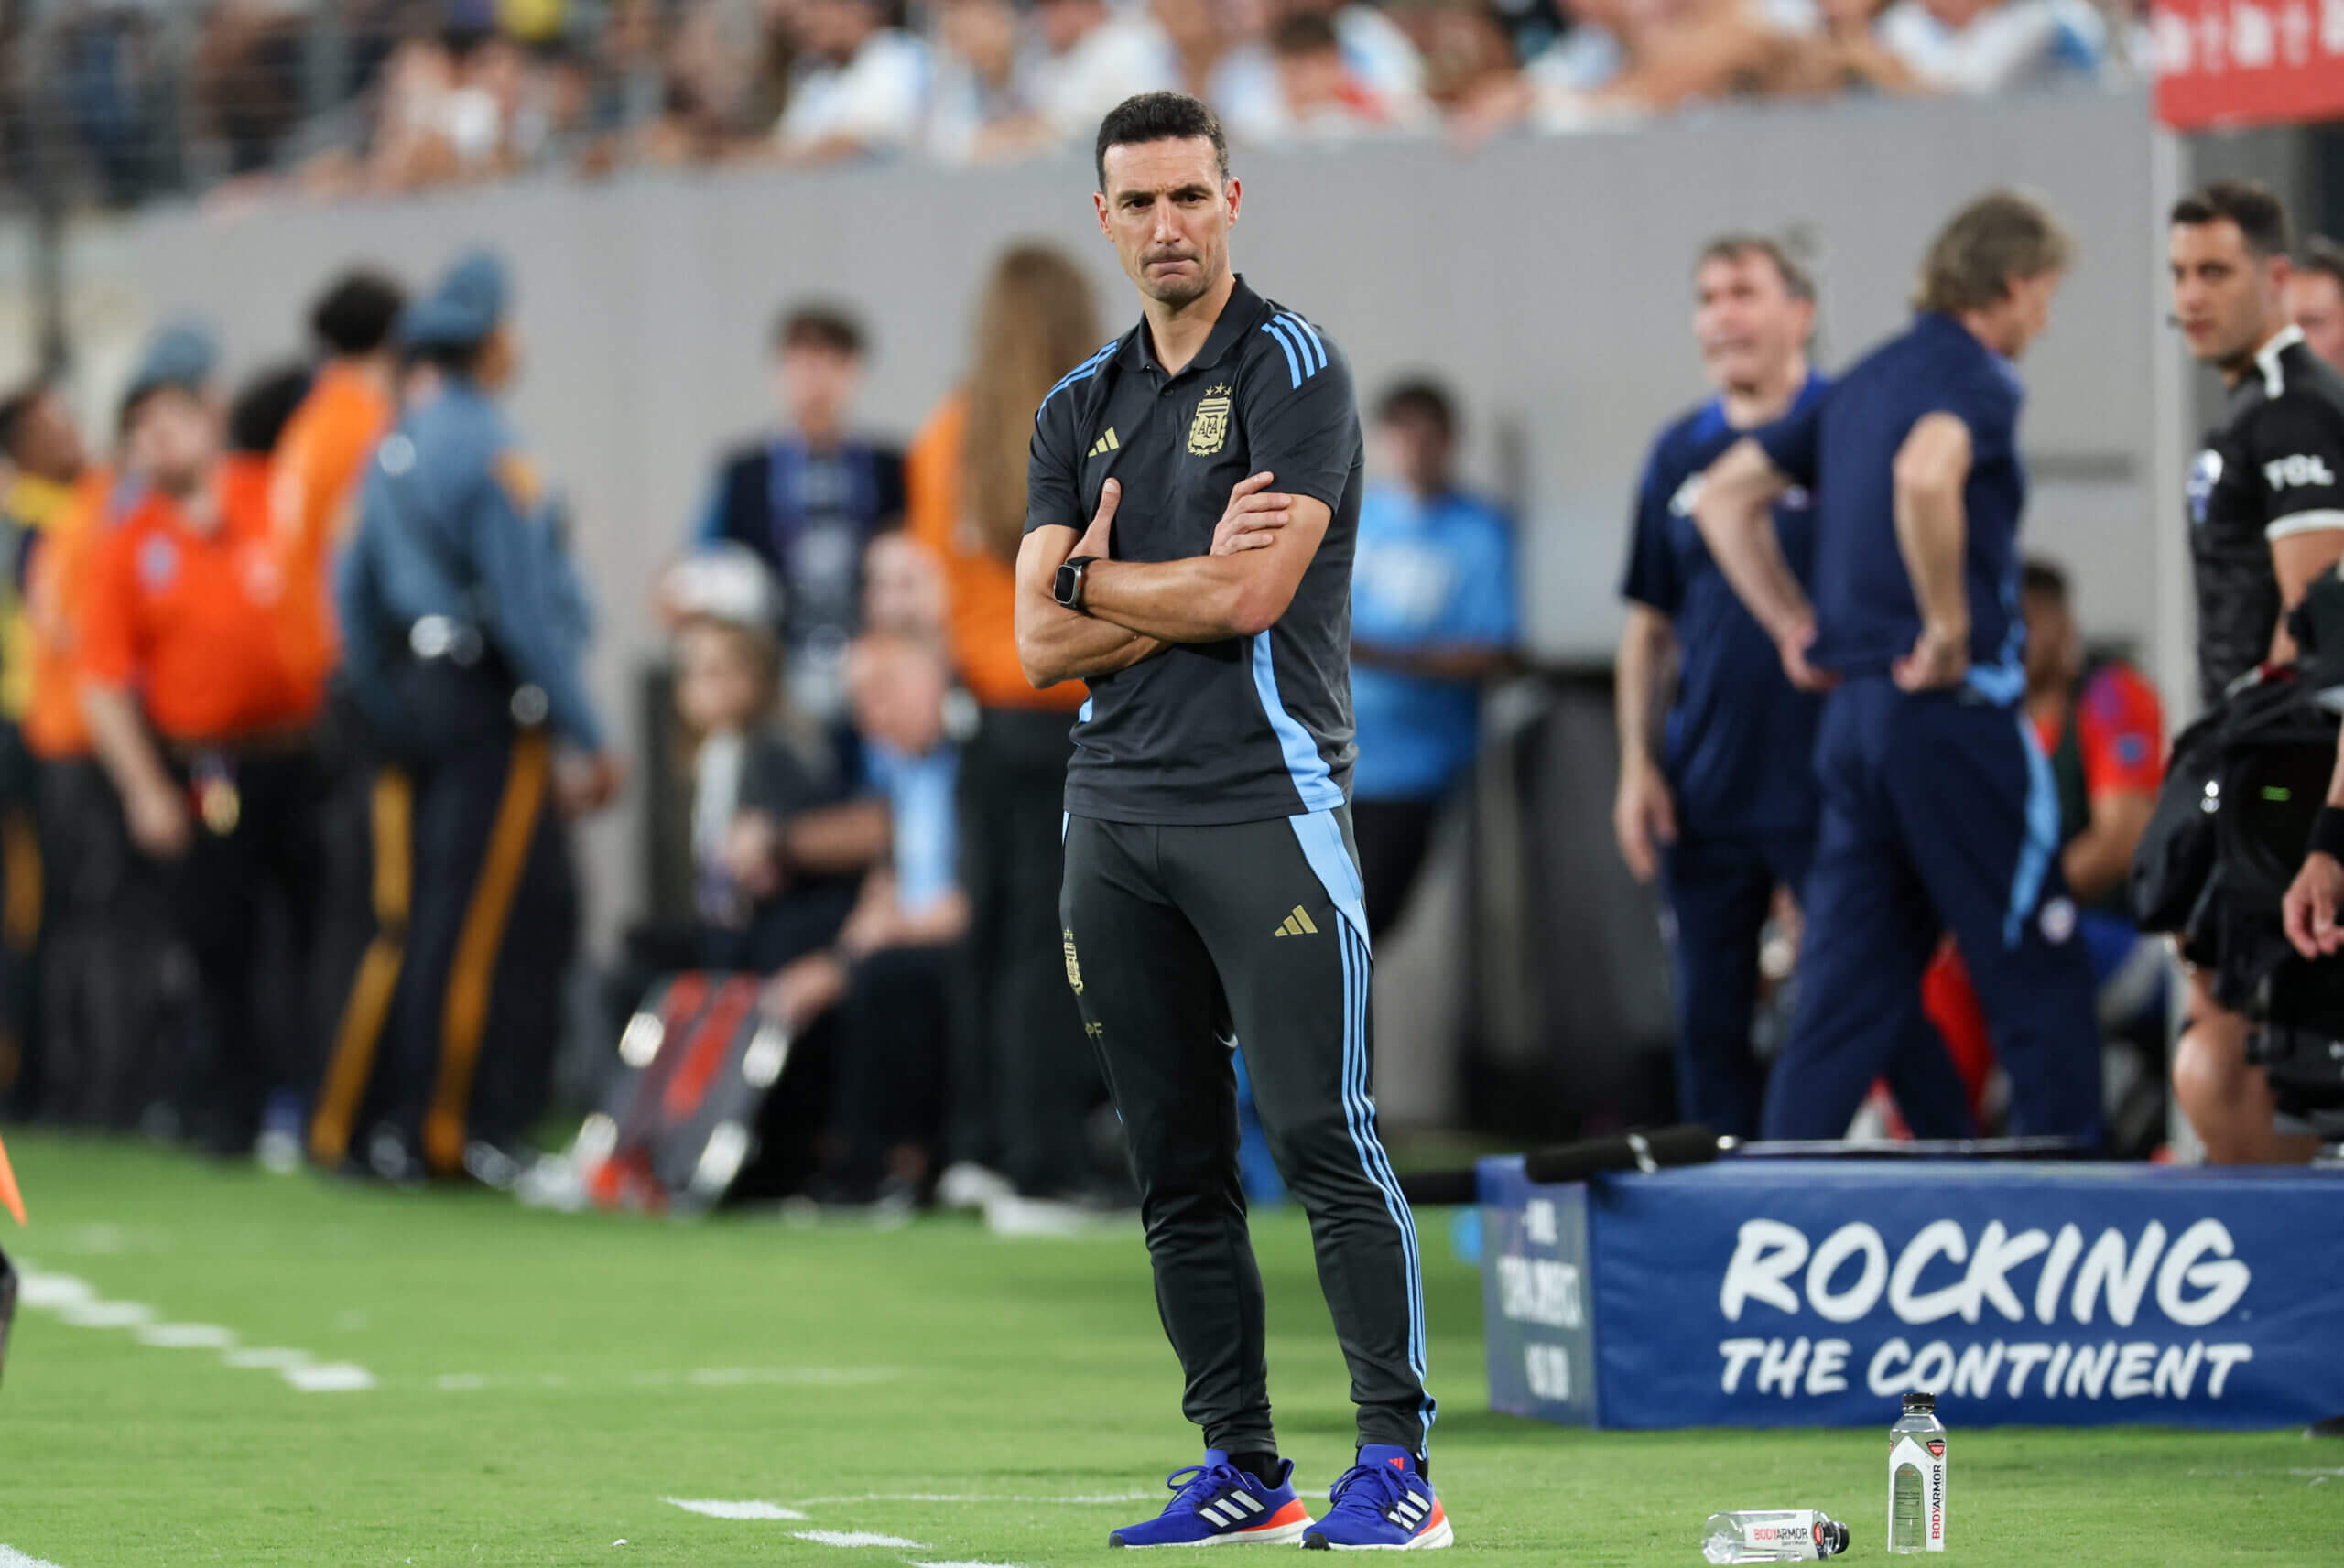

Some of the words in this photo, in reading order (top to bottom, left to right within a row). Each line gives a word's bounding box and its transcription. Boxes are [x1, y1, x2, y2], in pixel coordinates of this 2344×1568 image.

[1720, 1218, 2252, 1326] ROCKING
[1719, 1336, 1851, 1397] THE
[1867, 1337, 2252, 1399] CONTINENT
[1753, 1527, 1808, 1541] BODYARMOR
[1932, 1465, 1942, 1539] BODYARMOR
